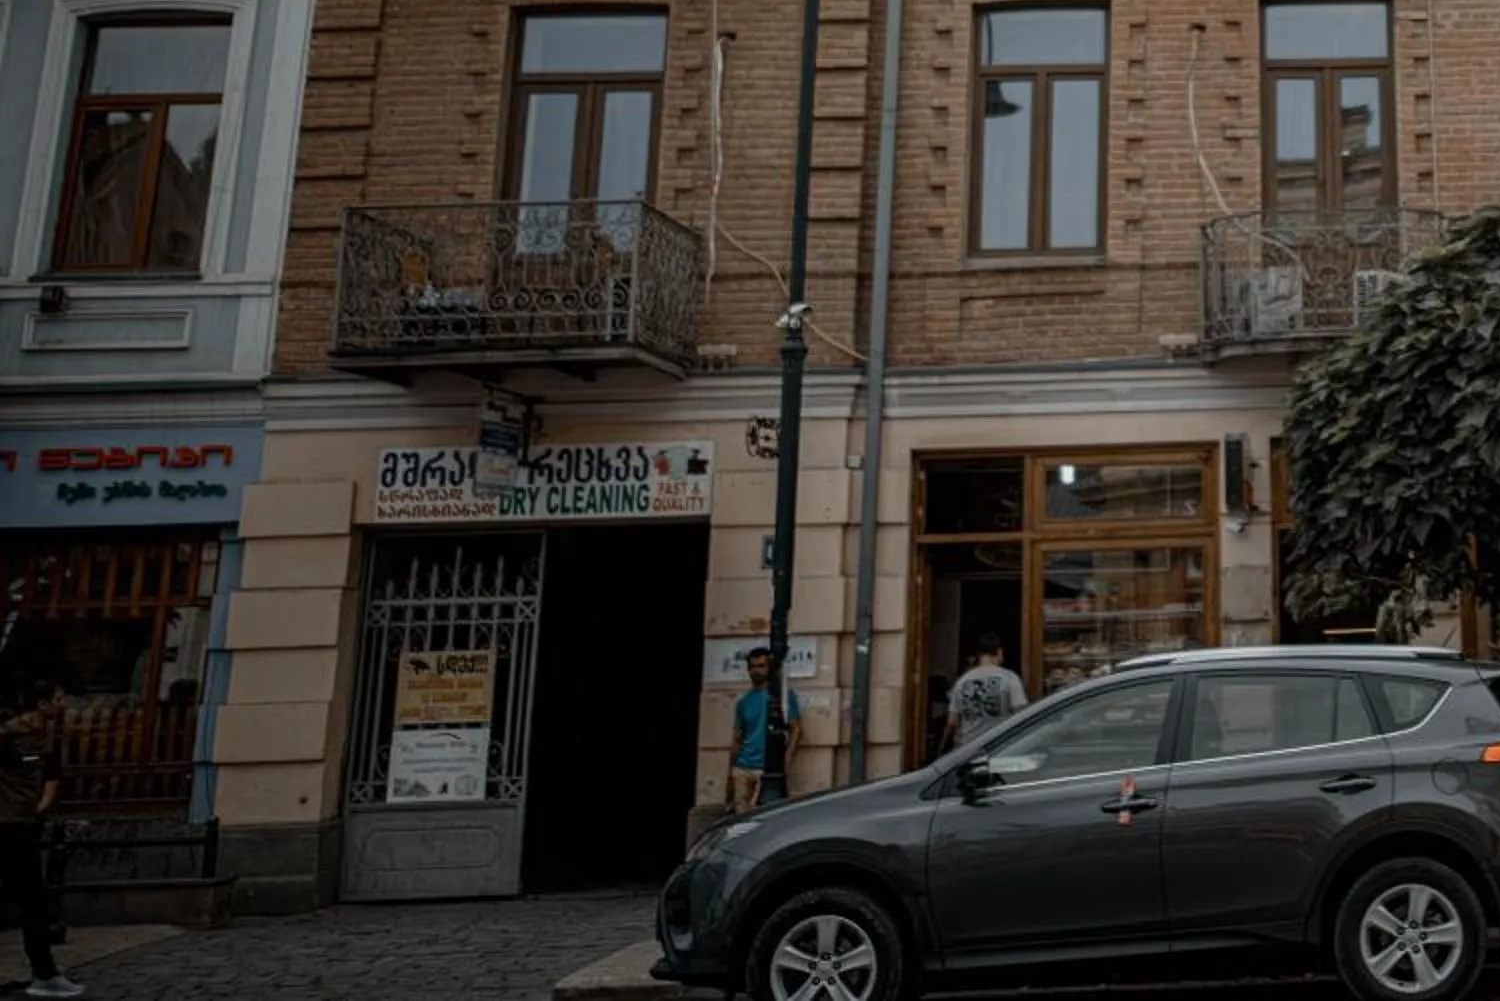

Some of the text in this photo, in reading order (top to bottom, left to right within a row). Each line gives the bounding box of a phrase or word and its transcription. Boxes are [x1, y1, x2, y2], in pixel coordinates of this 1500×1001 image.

[524, 447, 650, 484] რეცხვა
[499, 484, 650, 515] DRY CLEANING
[658, 482, 686, 495] FAST
[652, 497, 705, 511] QUALITY
